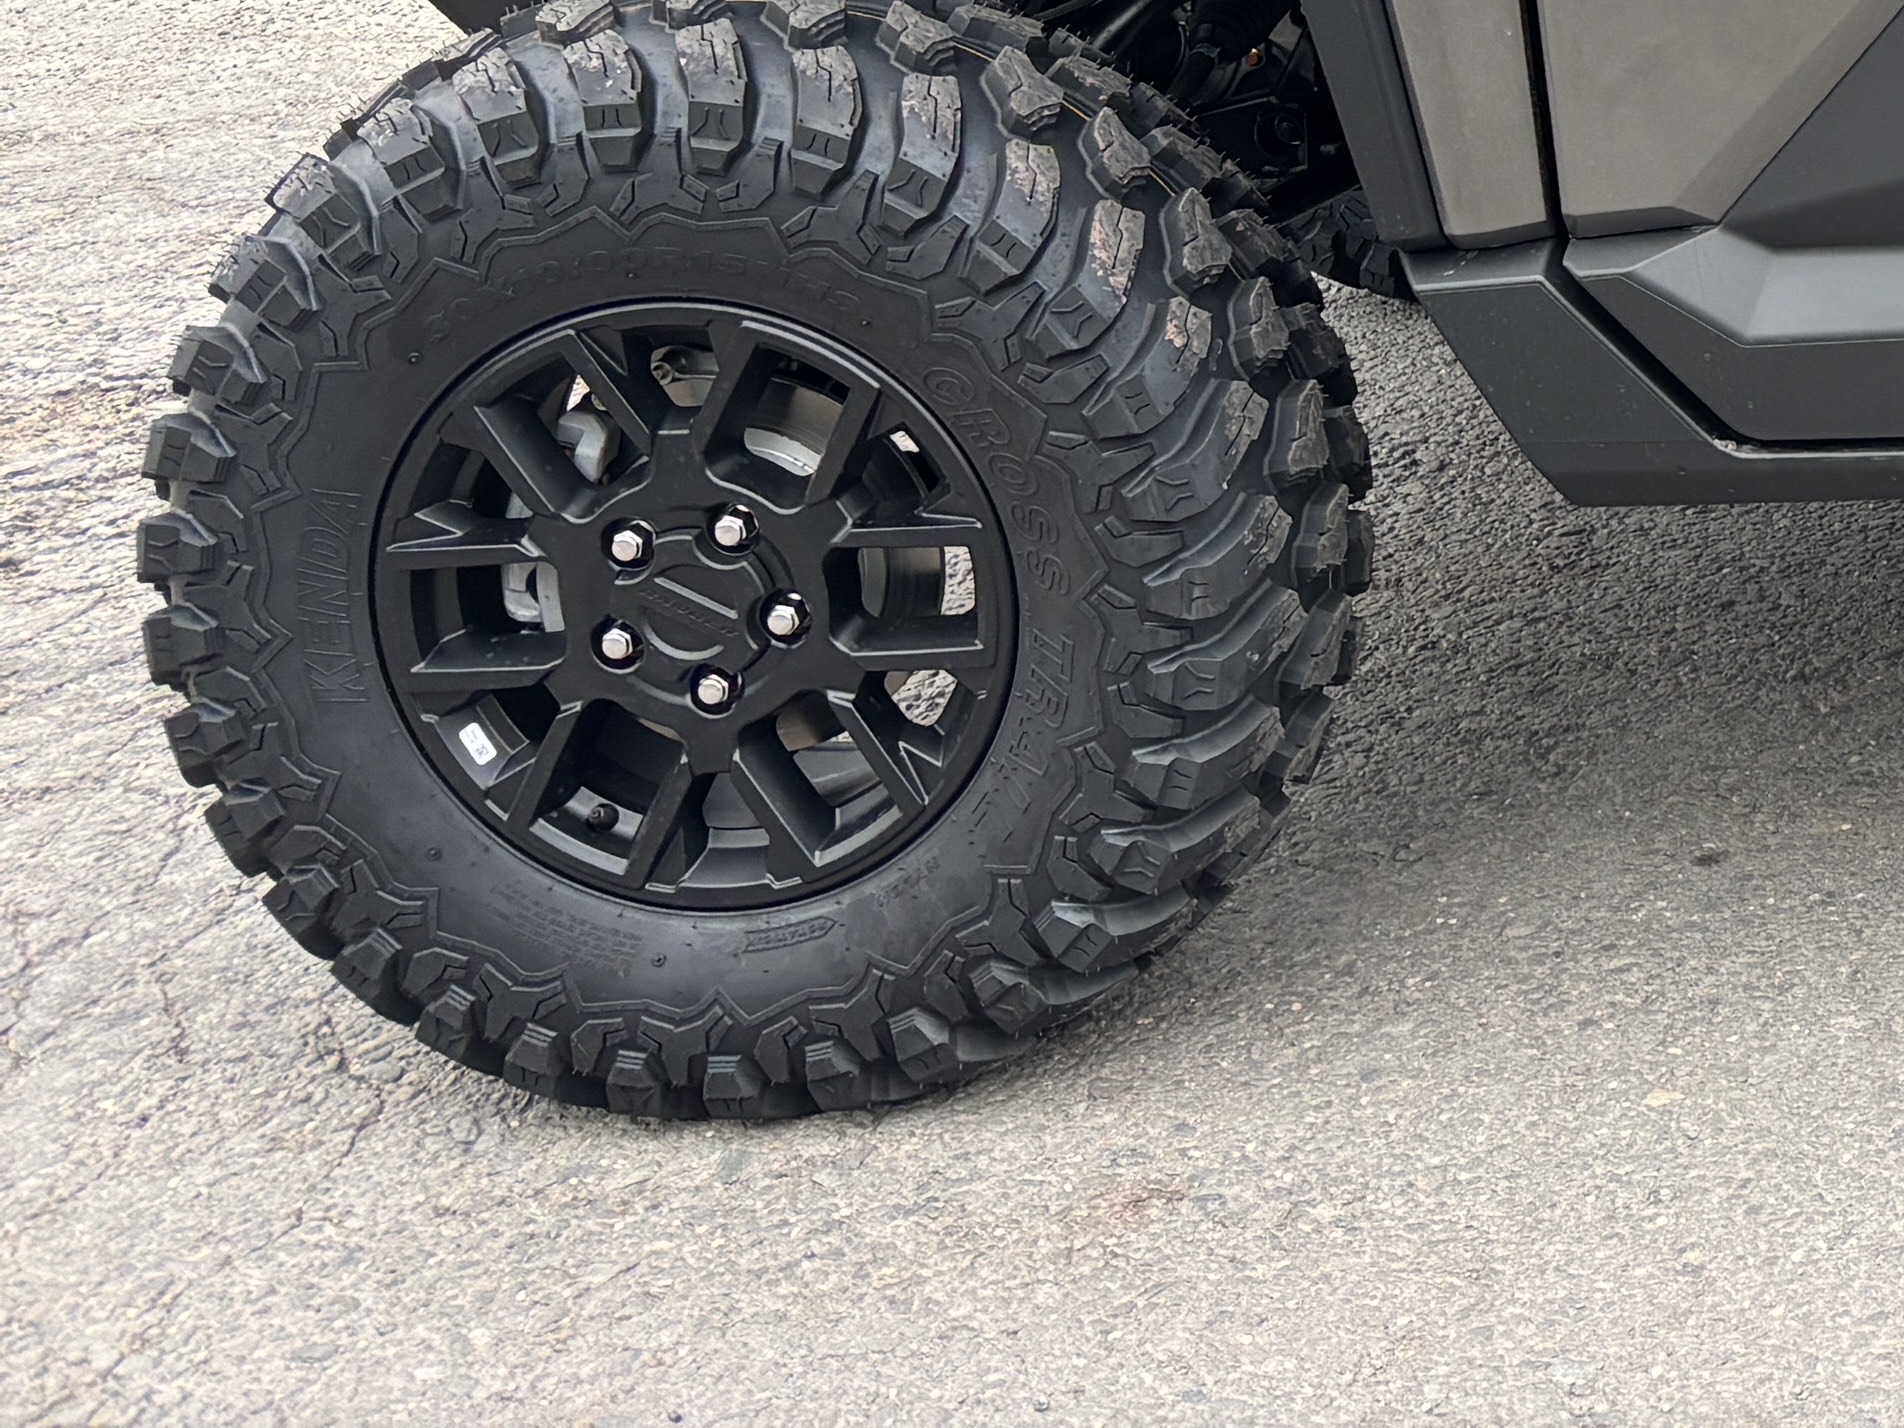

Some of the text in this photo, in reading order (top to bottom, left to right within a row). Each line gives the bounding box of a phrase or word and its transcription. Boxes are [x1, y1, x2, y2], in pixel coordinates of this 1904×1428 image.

[297, 487, 368, 704] KENDA
[918, 364, 1082, 840] CROSS TRAIL
